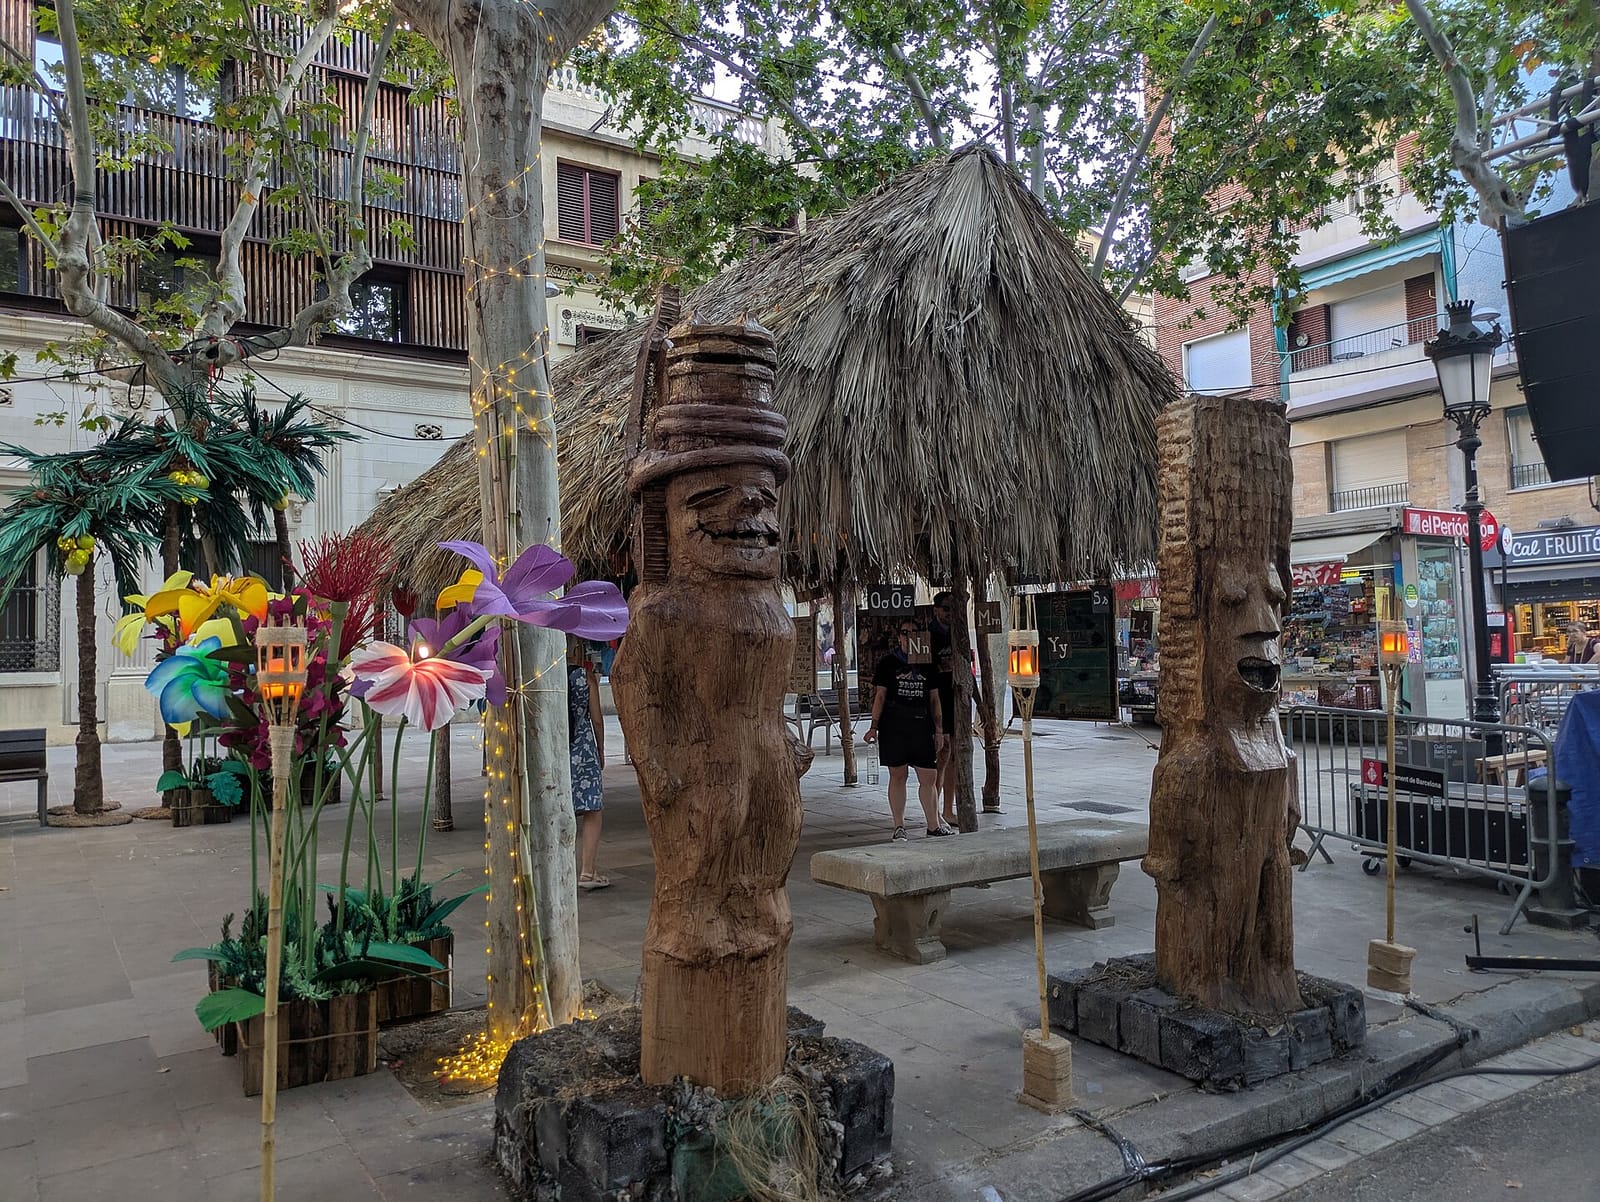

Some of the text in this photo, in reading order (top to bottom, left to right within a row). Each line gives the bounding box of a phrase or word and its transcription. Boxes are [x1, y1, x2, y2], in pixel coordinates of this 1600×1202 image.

[1512, 540, 1541, 557] Cal
[978, 609, 1001, 627] Mm
[909, 637, 930, 655] Nn
[1048, 636, 1068, 659] Yy
